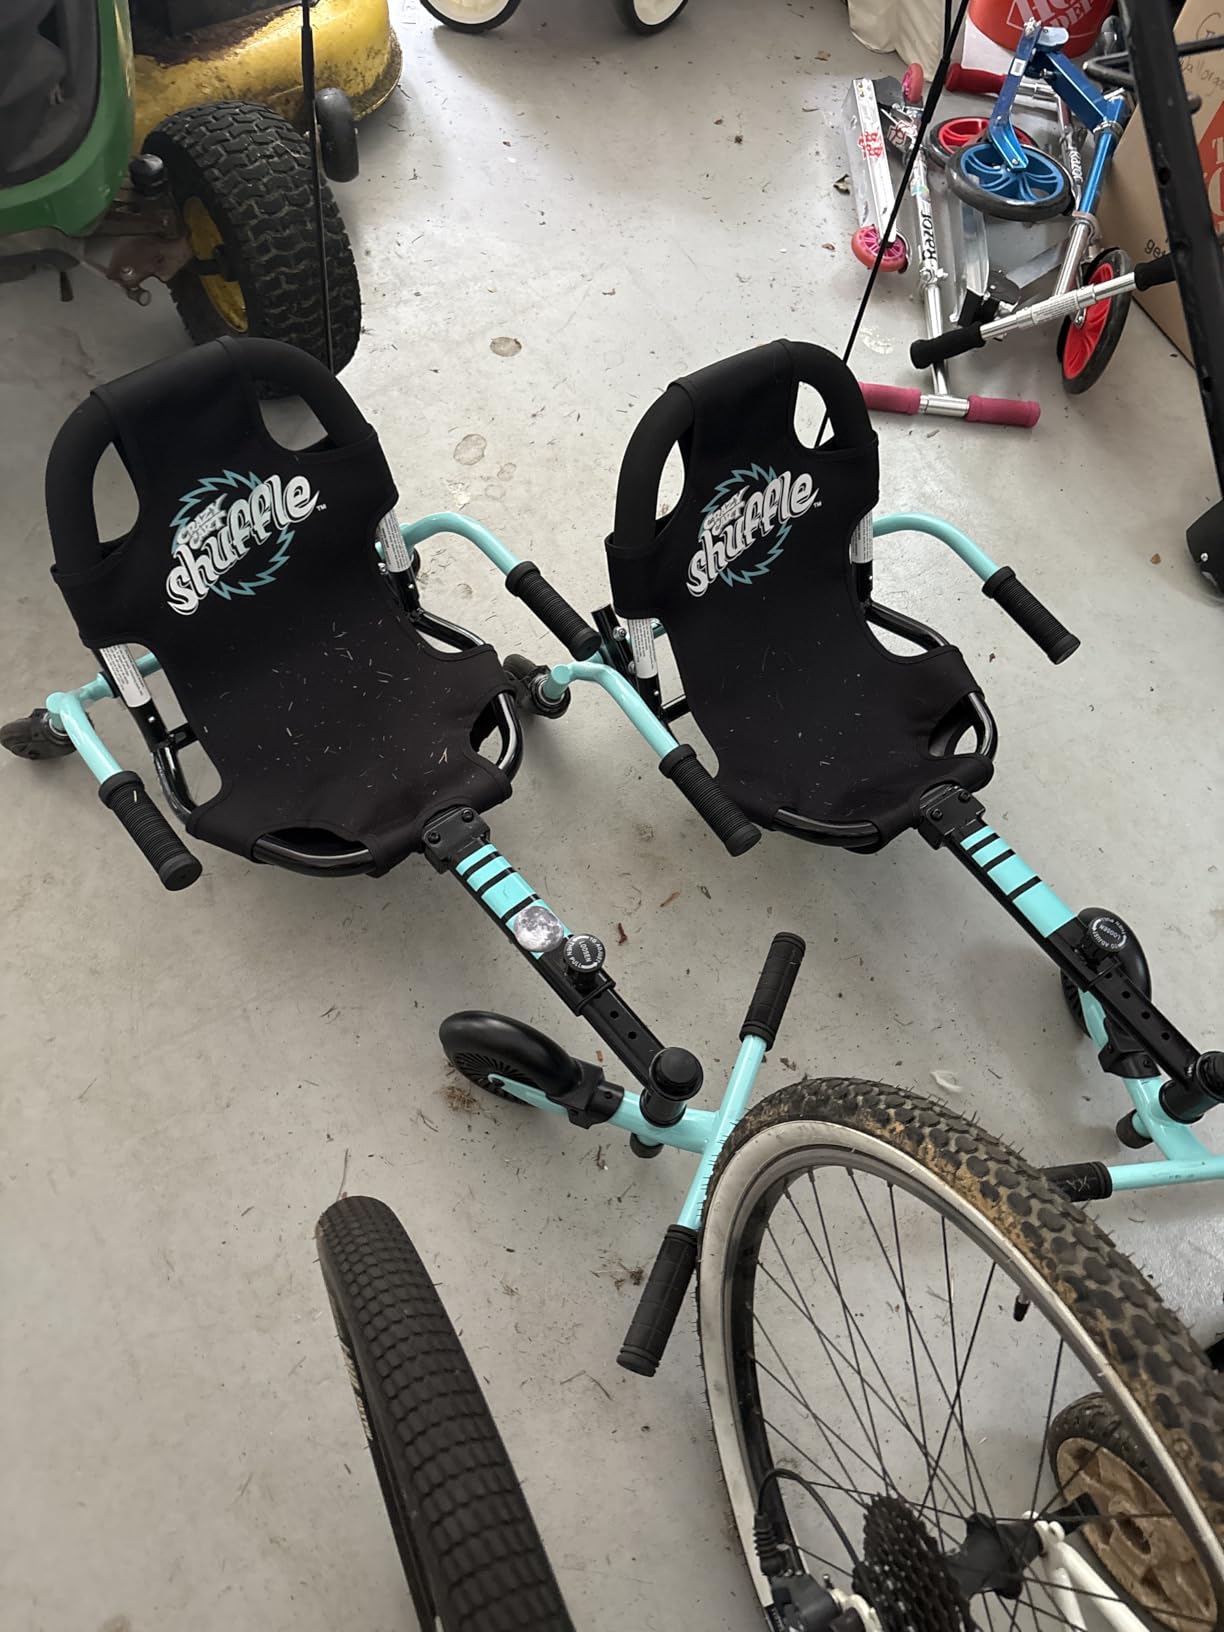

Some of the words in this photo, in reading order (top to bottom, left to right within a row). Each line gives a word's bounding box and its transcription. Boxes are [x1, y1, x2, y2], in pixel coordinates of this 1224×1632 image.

[921, 210, 937, 261] Razor
[176, 493, 228, 544] CRAZY
[703, 485, 750, 530] CRAZY
[711, 501, 746, 536] CART
[189, 510, 228, 550] CART
[1092, 931, 1109, 947] ADJUST
[1099, 925, 1121, 940] LOOSEN
[579, 941, 592, 962] LOOSEN
